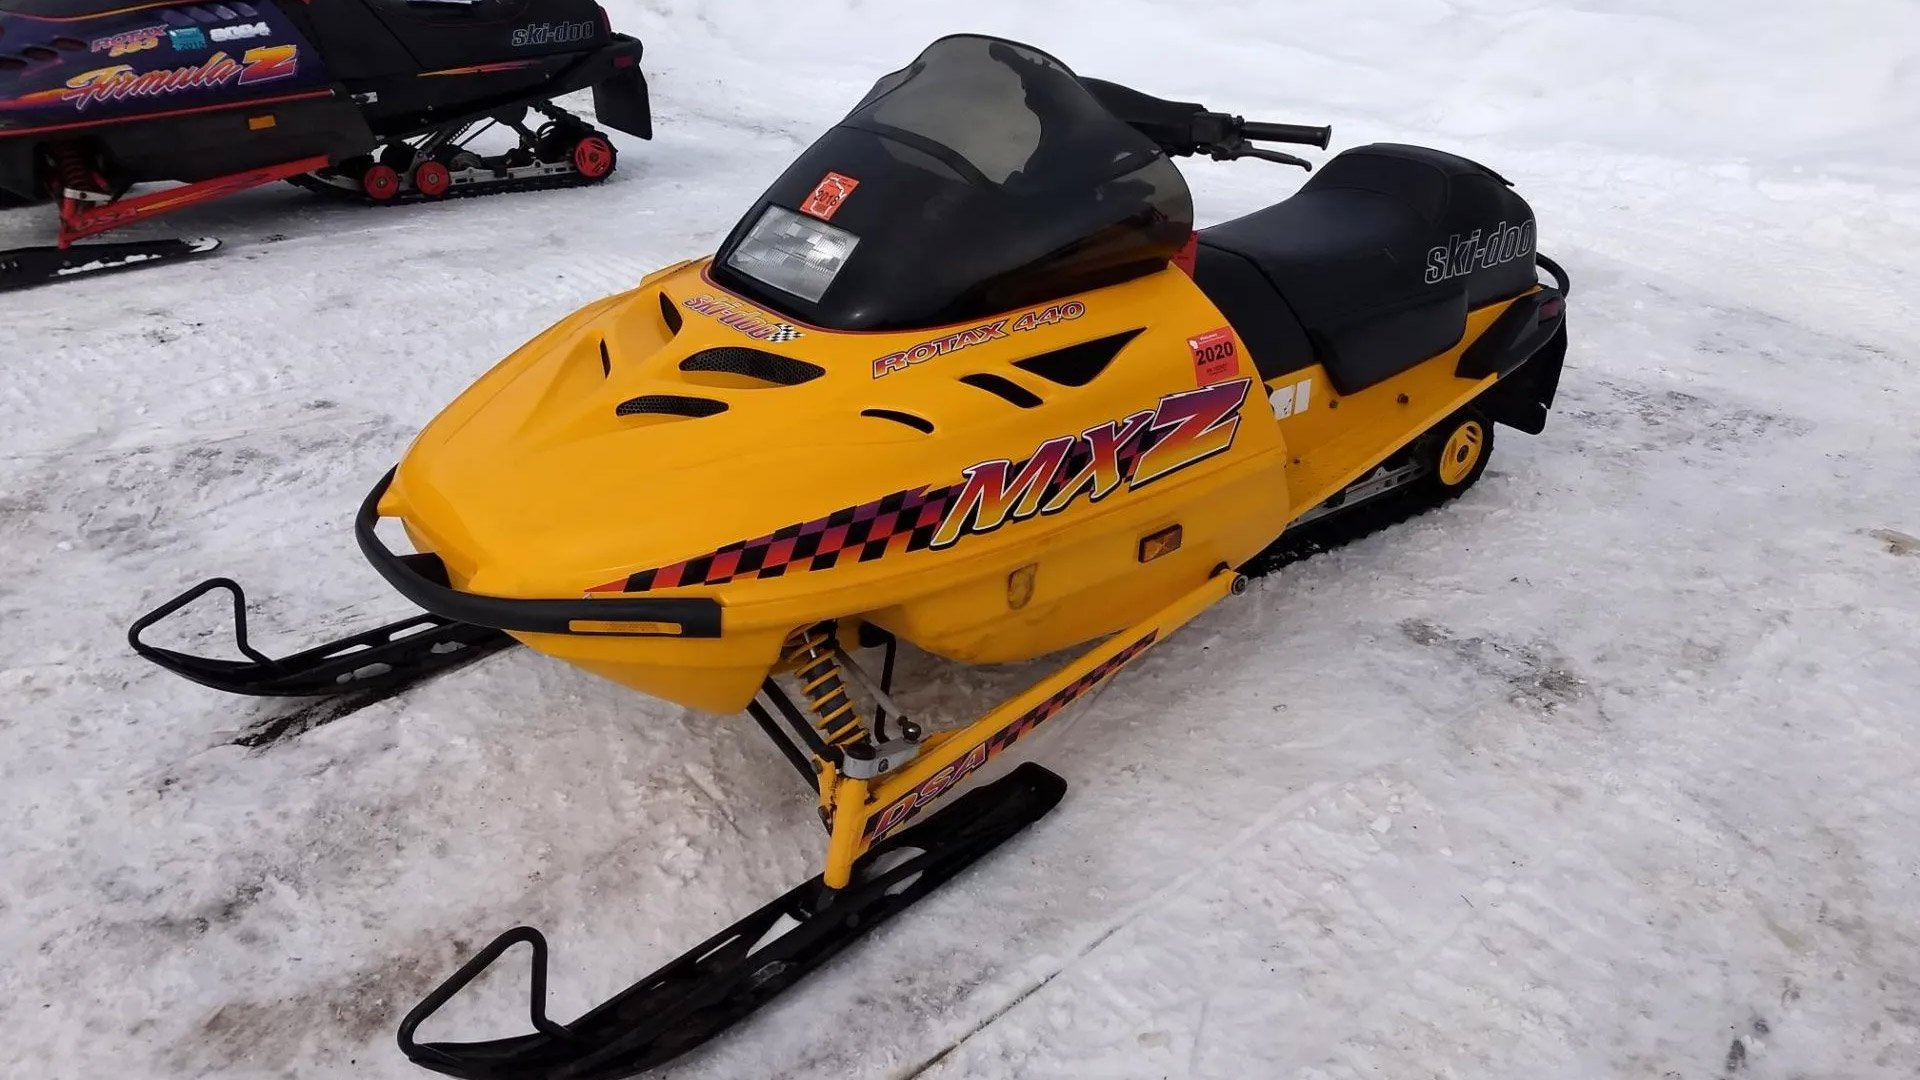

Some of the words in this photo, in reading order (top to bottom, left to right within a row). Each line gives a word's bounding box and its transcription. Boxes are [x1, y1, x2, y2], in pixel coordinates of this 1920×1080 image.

[512, 21, 594, 46] ski-doo
[61, 51, 243, 111] Formula
[238, 45, 297, 86] Z
[1424, 220, 1536, 284] ski-doo
[872, 319, 1010, 380] ROTAX
[1013, 301, 1085, 332] 440
[1196, 341, 1234, 366] 2020
[871, 742, 986, 840] DSA
